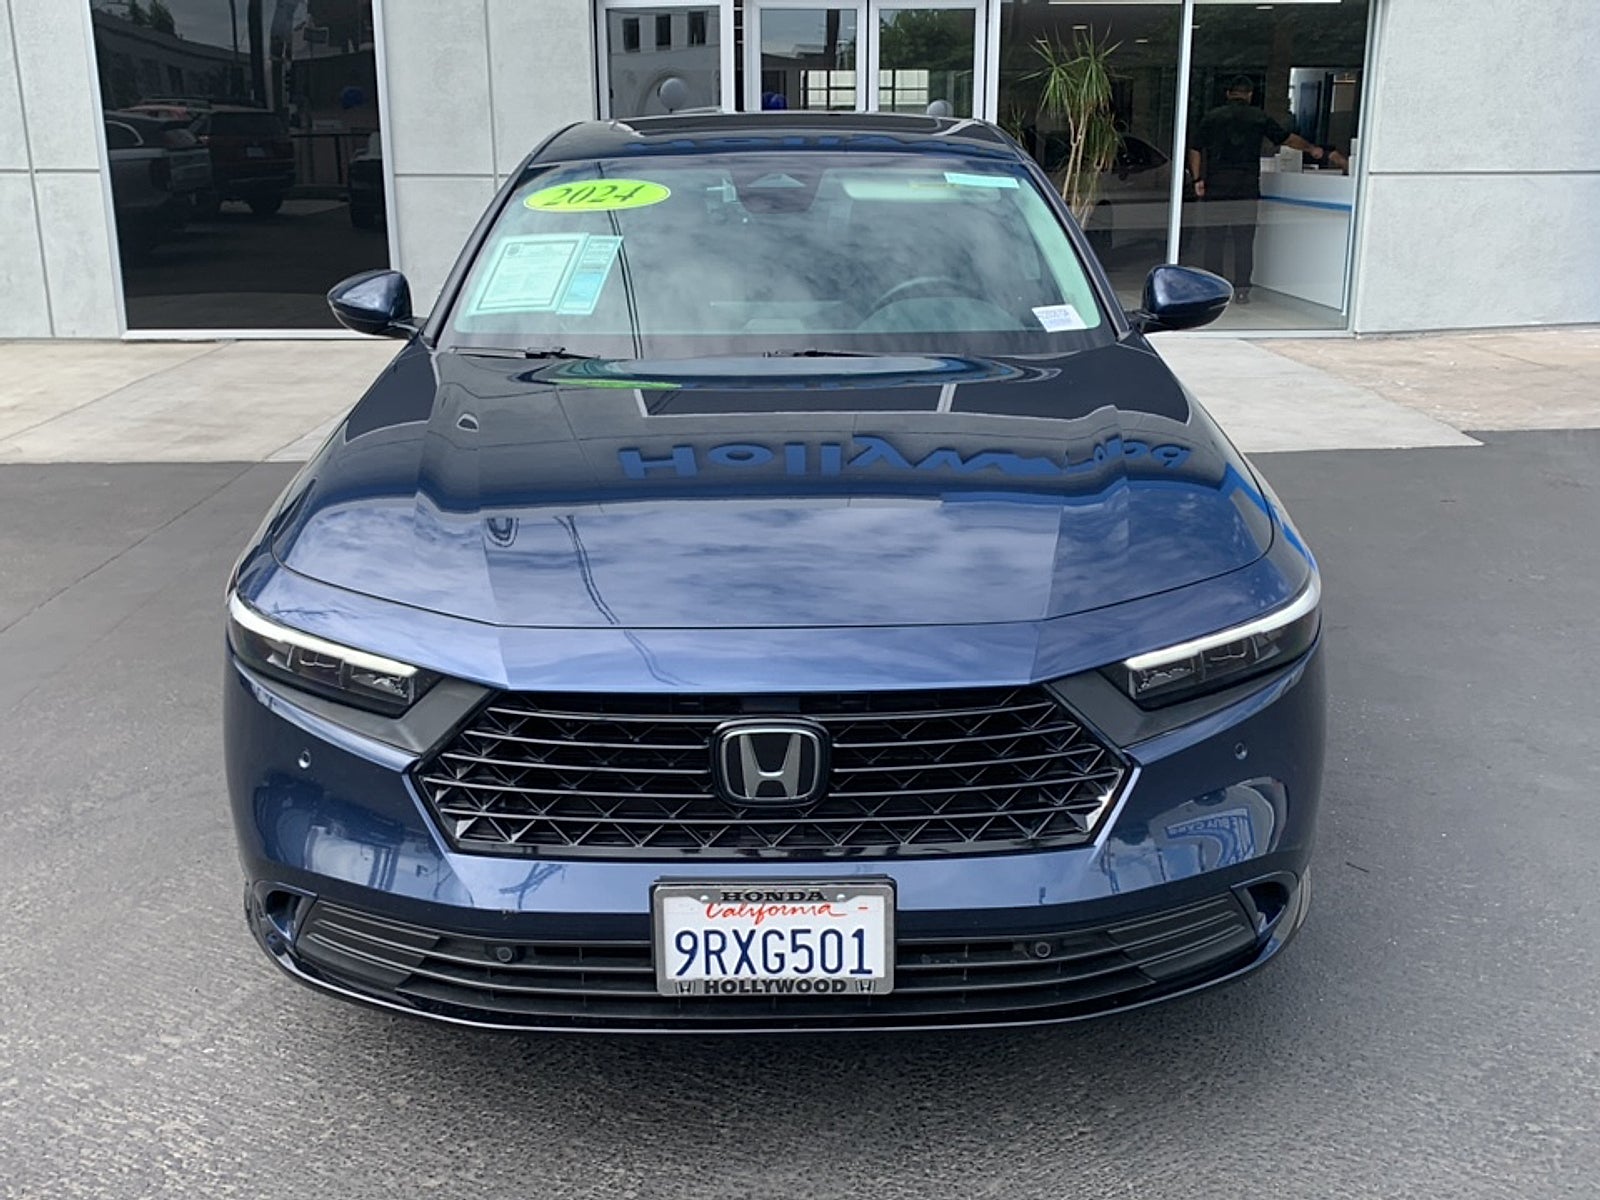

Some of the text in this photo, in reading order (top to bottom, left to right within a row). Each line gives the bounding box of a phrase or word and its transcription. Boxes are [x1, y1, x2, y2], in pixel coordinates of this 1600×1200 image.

[543, 184, 646, 206] 2024
[720, 890, 828, 902] HONDA
[705, 900, 848, 925] California
[674, 928, 873, 977] 9RXG501
[703, 979, 848, 995] HOLLYWOOD
